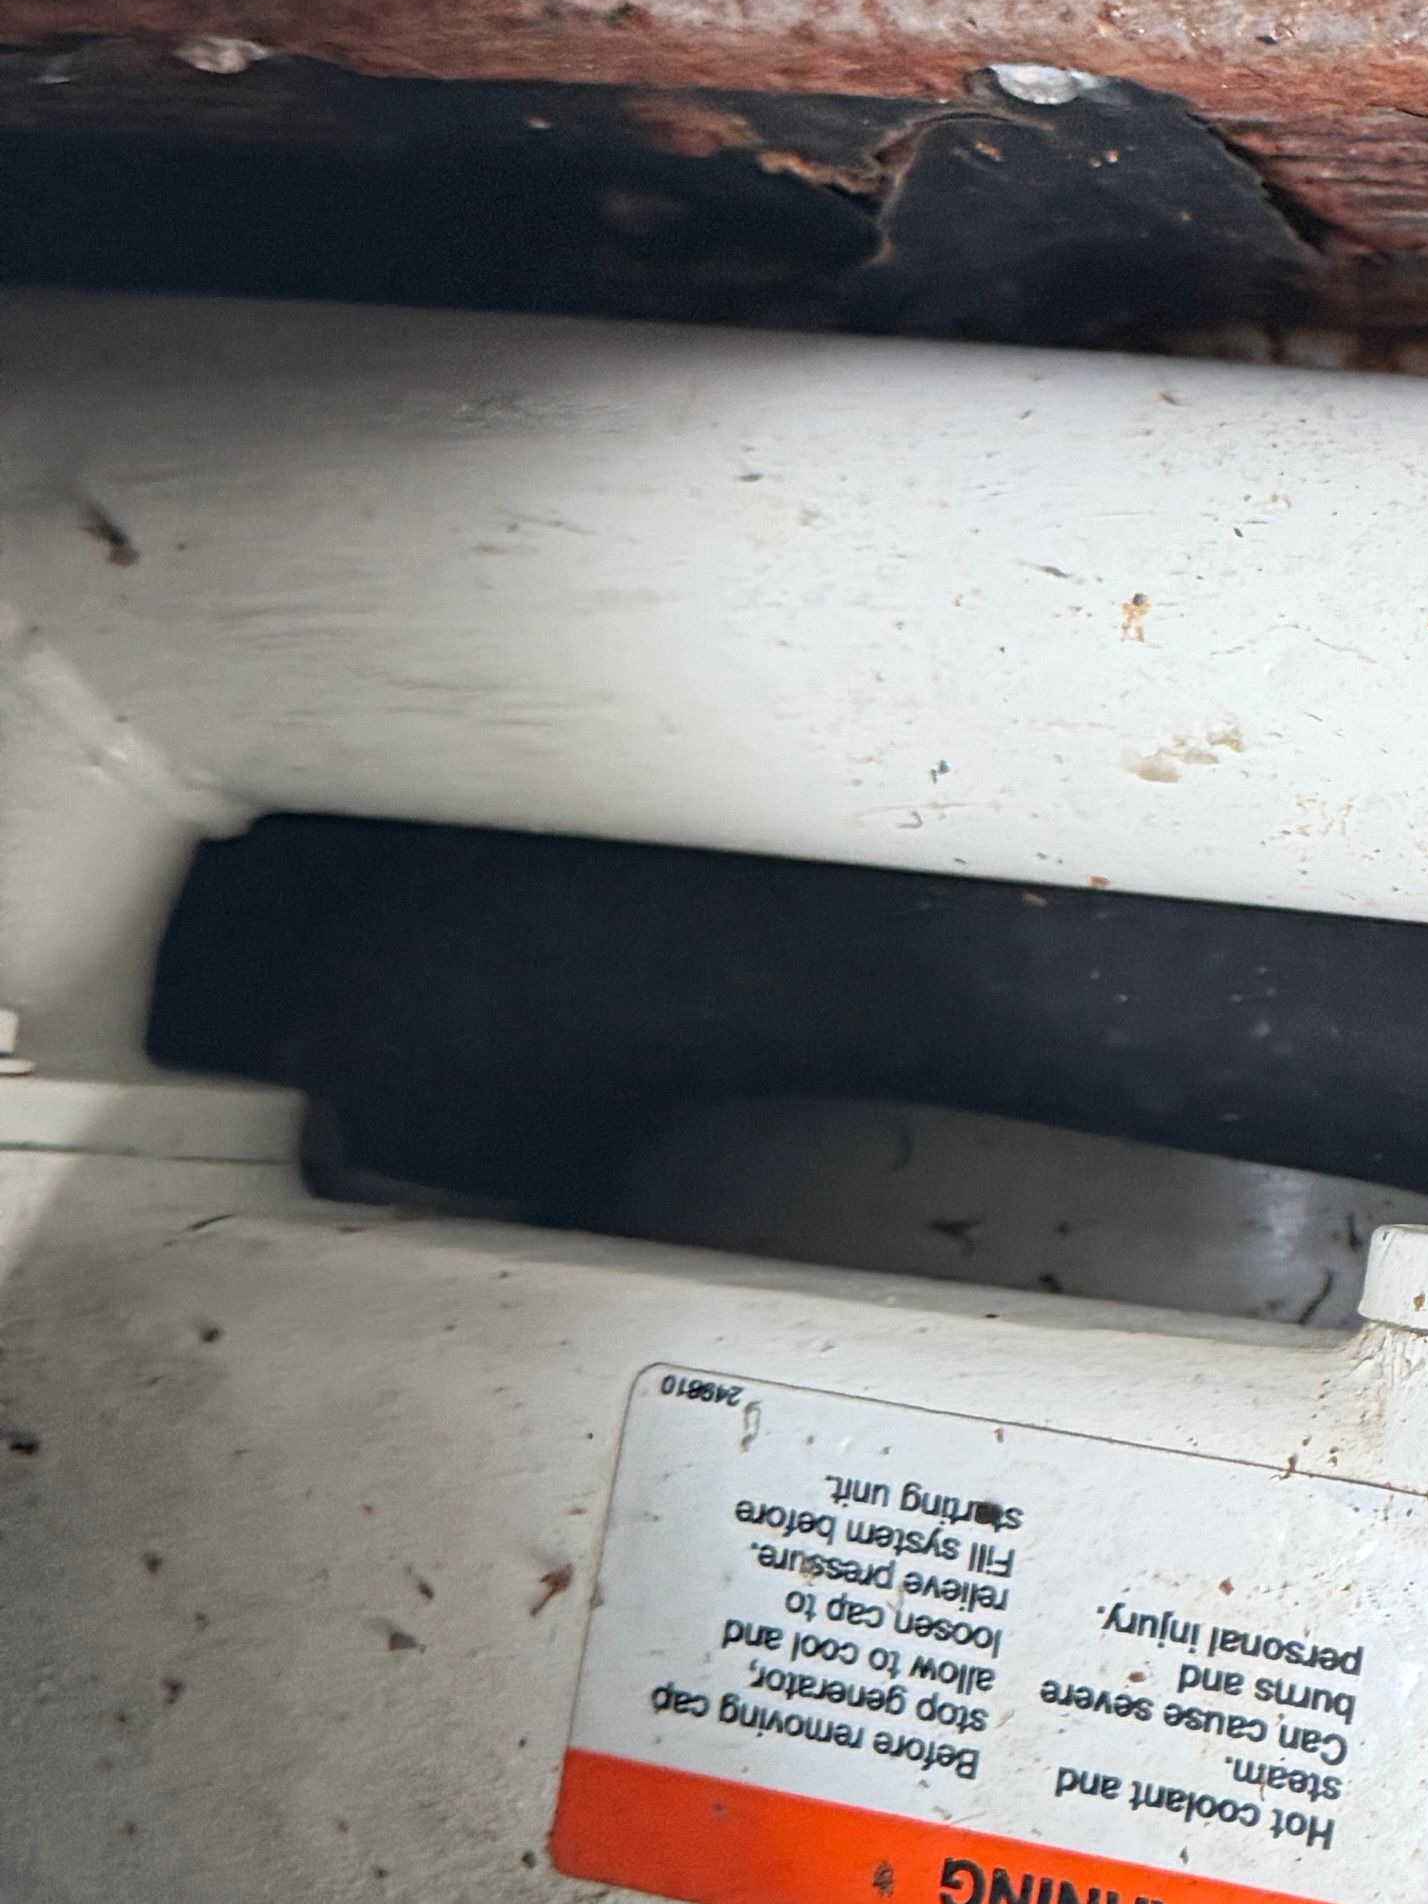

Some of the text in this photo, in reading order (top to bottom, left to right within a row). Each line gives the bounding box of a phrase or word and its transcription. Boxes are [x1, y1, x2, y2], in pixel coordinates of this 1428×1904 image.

[735, 1500, 1016, 1578] Fill system before
[825, 1474, 1024, 1533] strting unit.
[750, 1542, 1009, 1613] relieve pressure.
[721, 1619, 996, 1696] allow to cool and
[785, 1591, 1002, 1659] loosen cap to
[1096, 1602, 1364, 1677] personal injury.
[651, 1683, 980, 1780] Before removing cap
[748, 1660, 990, 1735] stop generator,
[1040, 1680, 1349, 1766] Can cause severe
[1177, 1664, 1357, 1724] burns and
[1055, 1767, 1335, 1851] Hot coolant and
[1224, 1757, 1342, 1803] steam.
